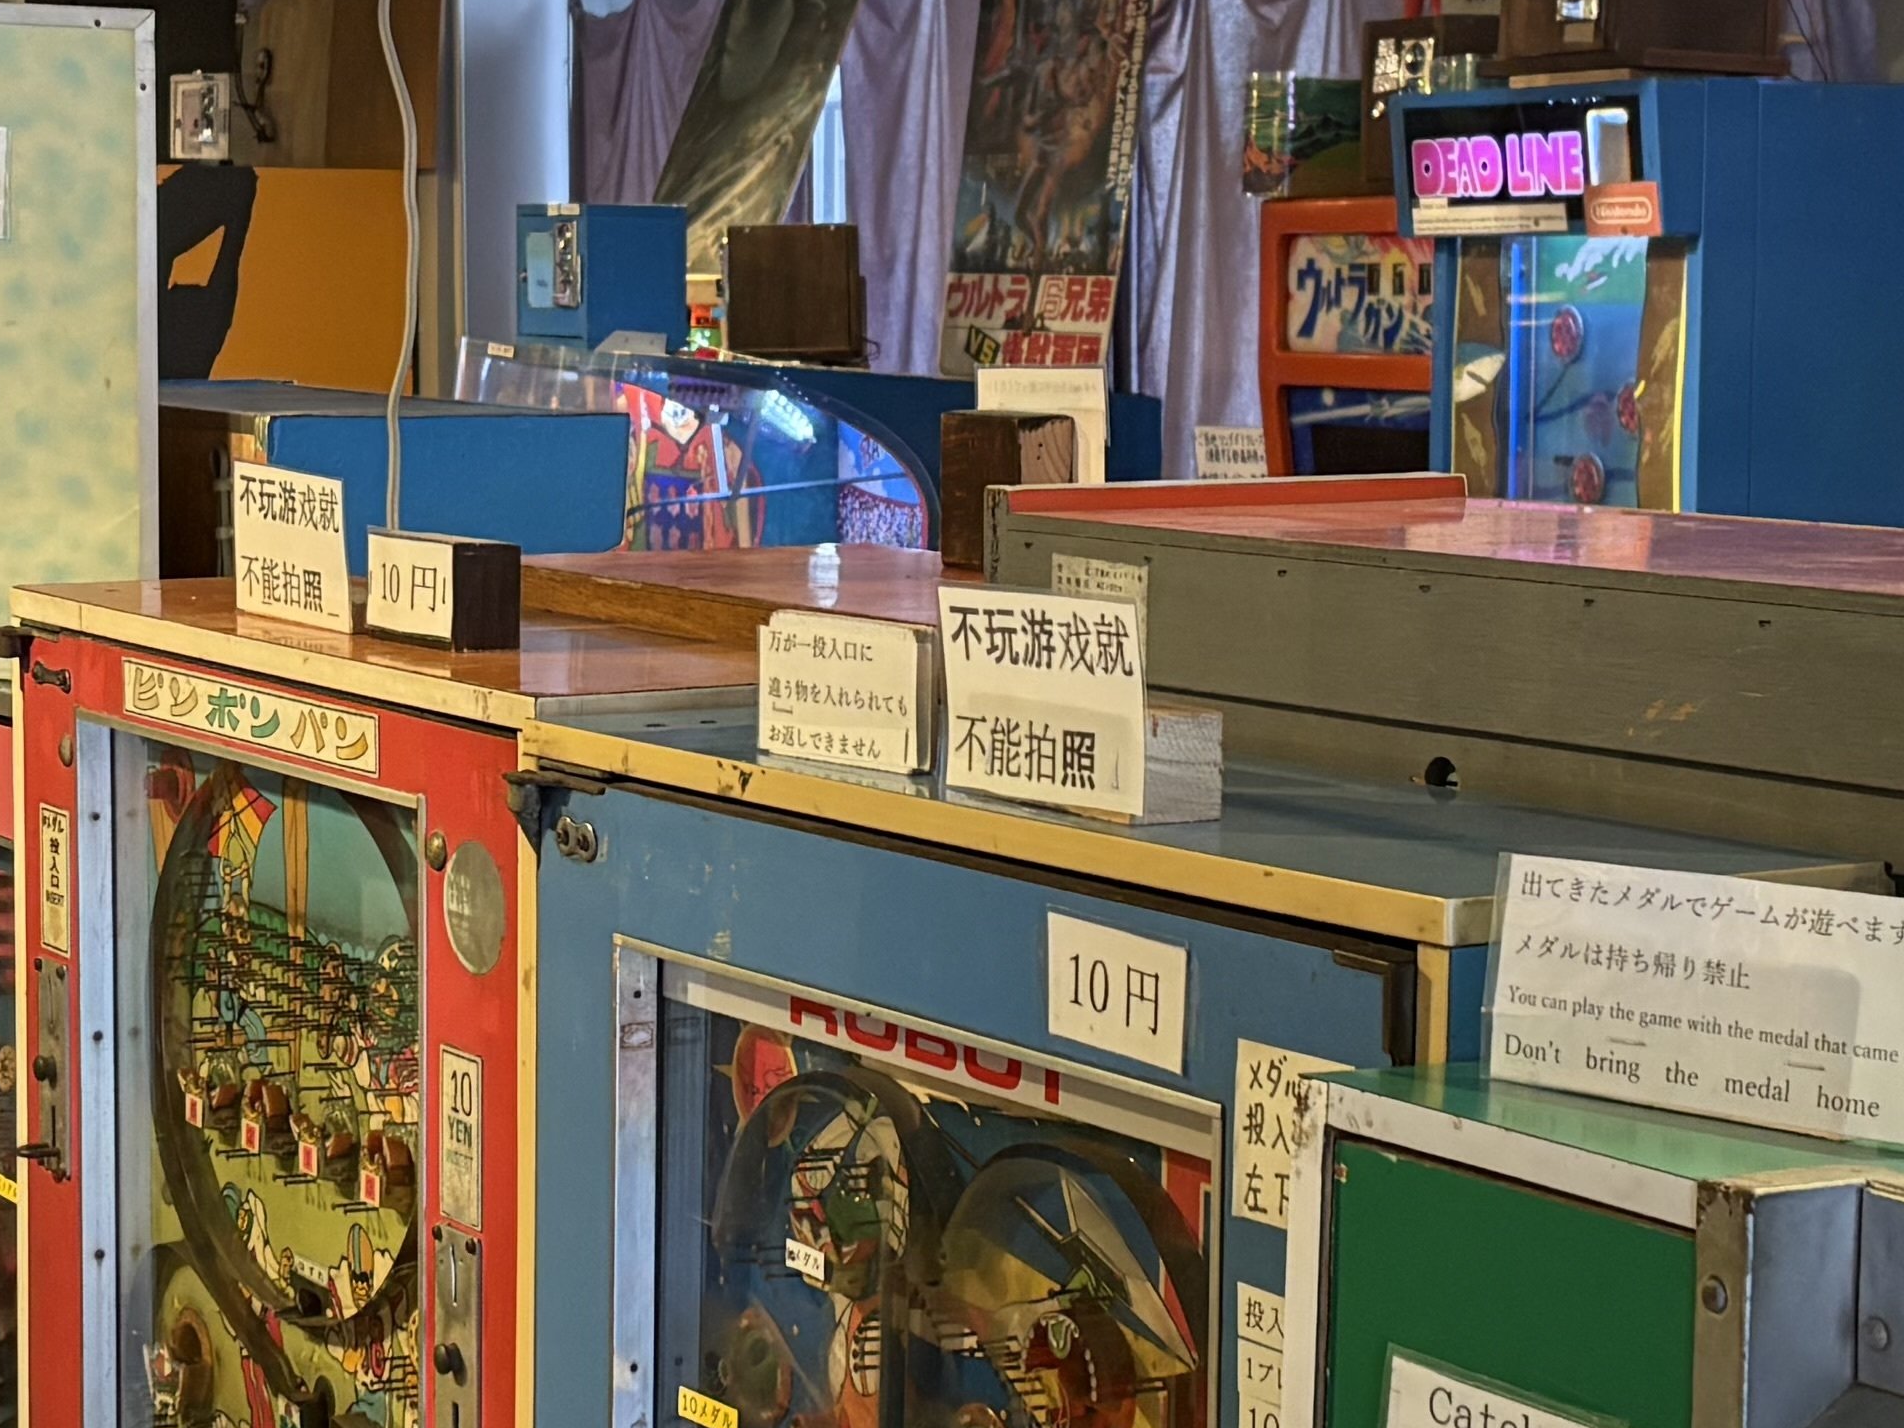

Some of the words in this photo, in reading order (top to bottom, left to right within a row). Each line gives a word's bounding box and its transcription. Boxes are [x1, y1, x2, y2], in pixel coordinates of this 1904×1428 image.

[1412, 135, 1503, 199] DEAD
[1505, 130, 1585, 197] LINE
[239, 474, 340, 534] 不玩游戏就
[239, 555, 324, 614] 不能拍照
[381, 562, 400, 604] 10
[410, 565, 438, 612] 円
[768, 630, 874, 663] 万が一投入口に
[949, 605, 1134, 677] 不玩游戏就
[767, 676, 908, 718] 違う物を入れられても
[768, 724, 881, 760] お返しできません
[954, 715, 1097, 791] 不能拍照
[1516, 933, 1750, 990] メダルは持ち帰り禁止
[1069, 953, 1109, 1014] 10
[1126, 963, 1160, 1037] 円
[1508, 984, 1538, 1007] You
[1541, 991, 1568, 1012] can
[1572, 993, 1605, 1021] play
[1609, 1000, 1635, 1023] the
[1639, 1009, 1683, 1030] game
[1687, 1013, 1723, 1035] with
[1727, 1019, 1754, 1041] the
[1759, 1027, 1810, 1050] medal
[1814, 1033, 1848, 1056] that
[1852, 1043, 1900, 1065] came
[449, 1071, 473, 1117] 10
[1505, 1032, 1562, 1066] Don't
[1585, 1046, 1641, 1084] bring
[1665, 1060, 1700, 1088] the
[1724, 1073, 1791, 1104] medal
[1816, 1084, 1881, 1119] home
[447, 1113, 473, 1149] YEN
